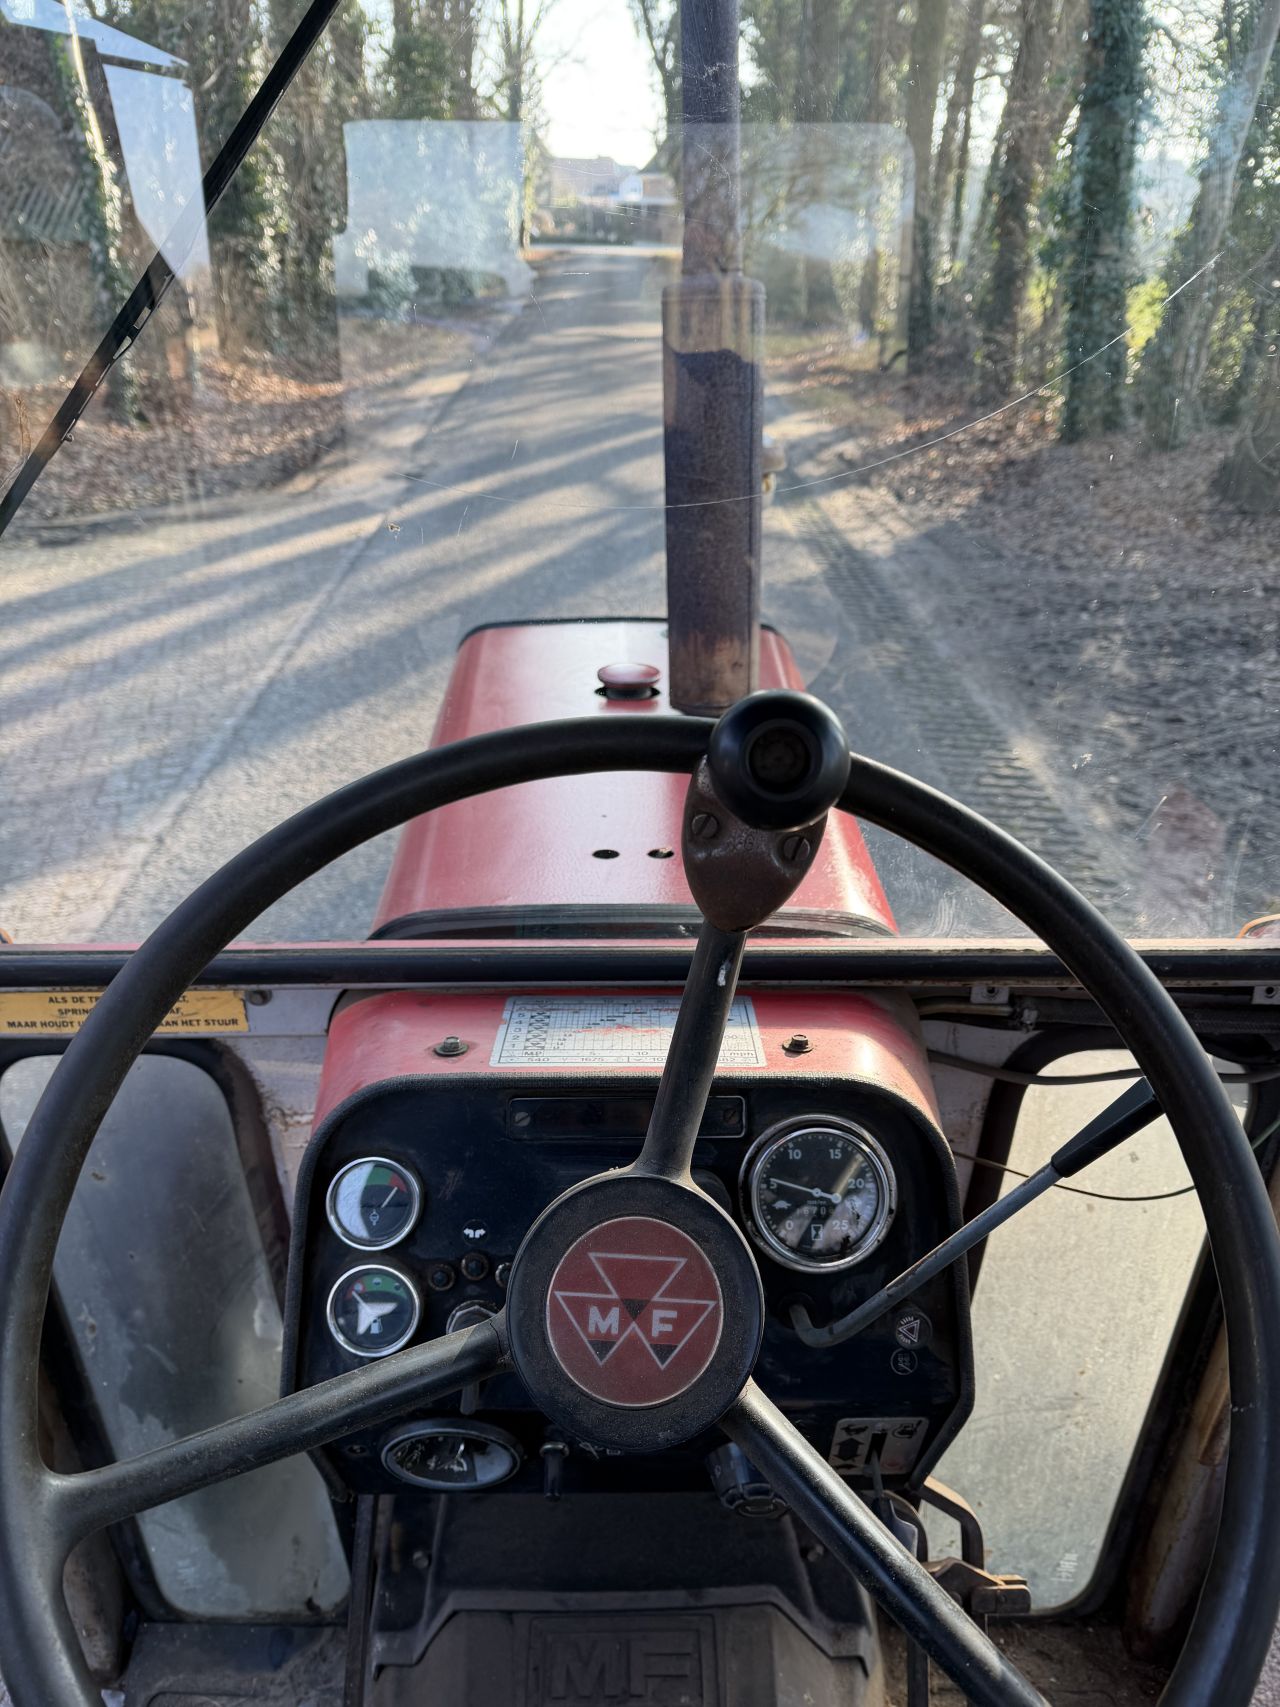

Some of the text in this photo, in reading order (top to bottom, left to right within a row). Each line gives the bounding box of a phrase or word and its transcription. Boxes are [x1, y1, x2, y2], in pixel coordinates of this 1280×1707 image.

[40, 1020, 74, 1028] HOUDT
[204, 1018, 239, 1026] STUUR
[787, 1149, 842, 1160] 10 15
[848, 1178, 865, 1189] 20
[785, 1219, 849, 1230] 0 25
